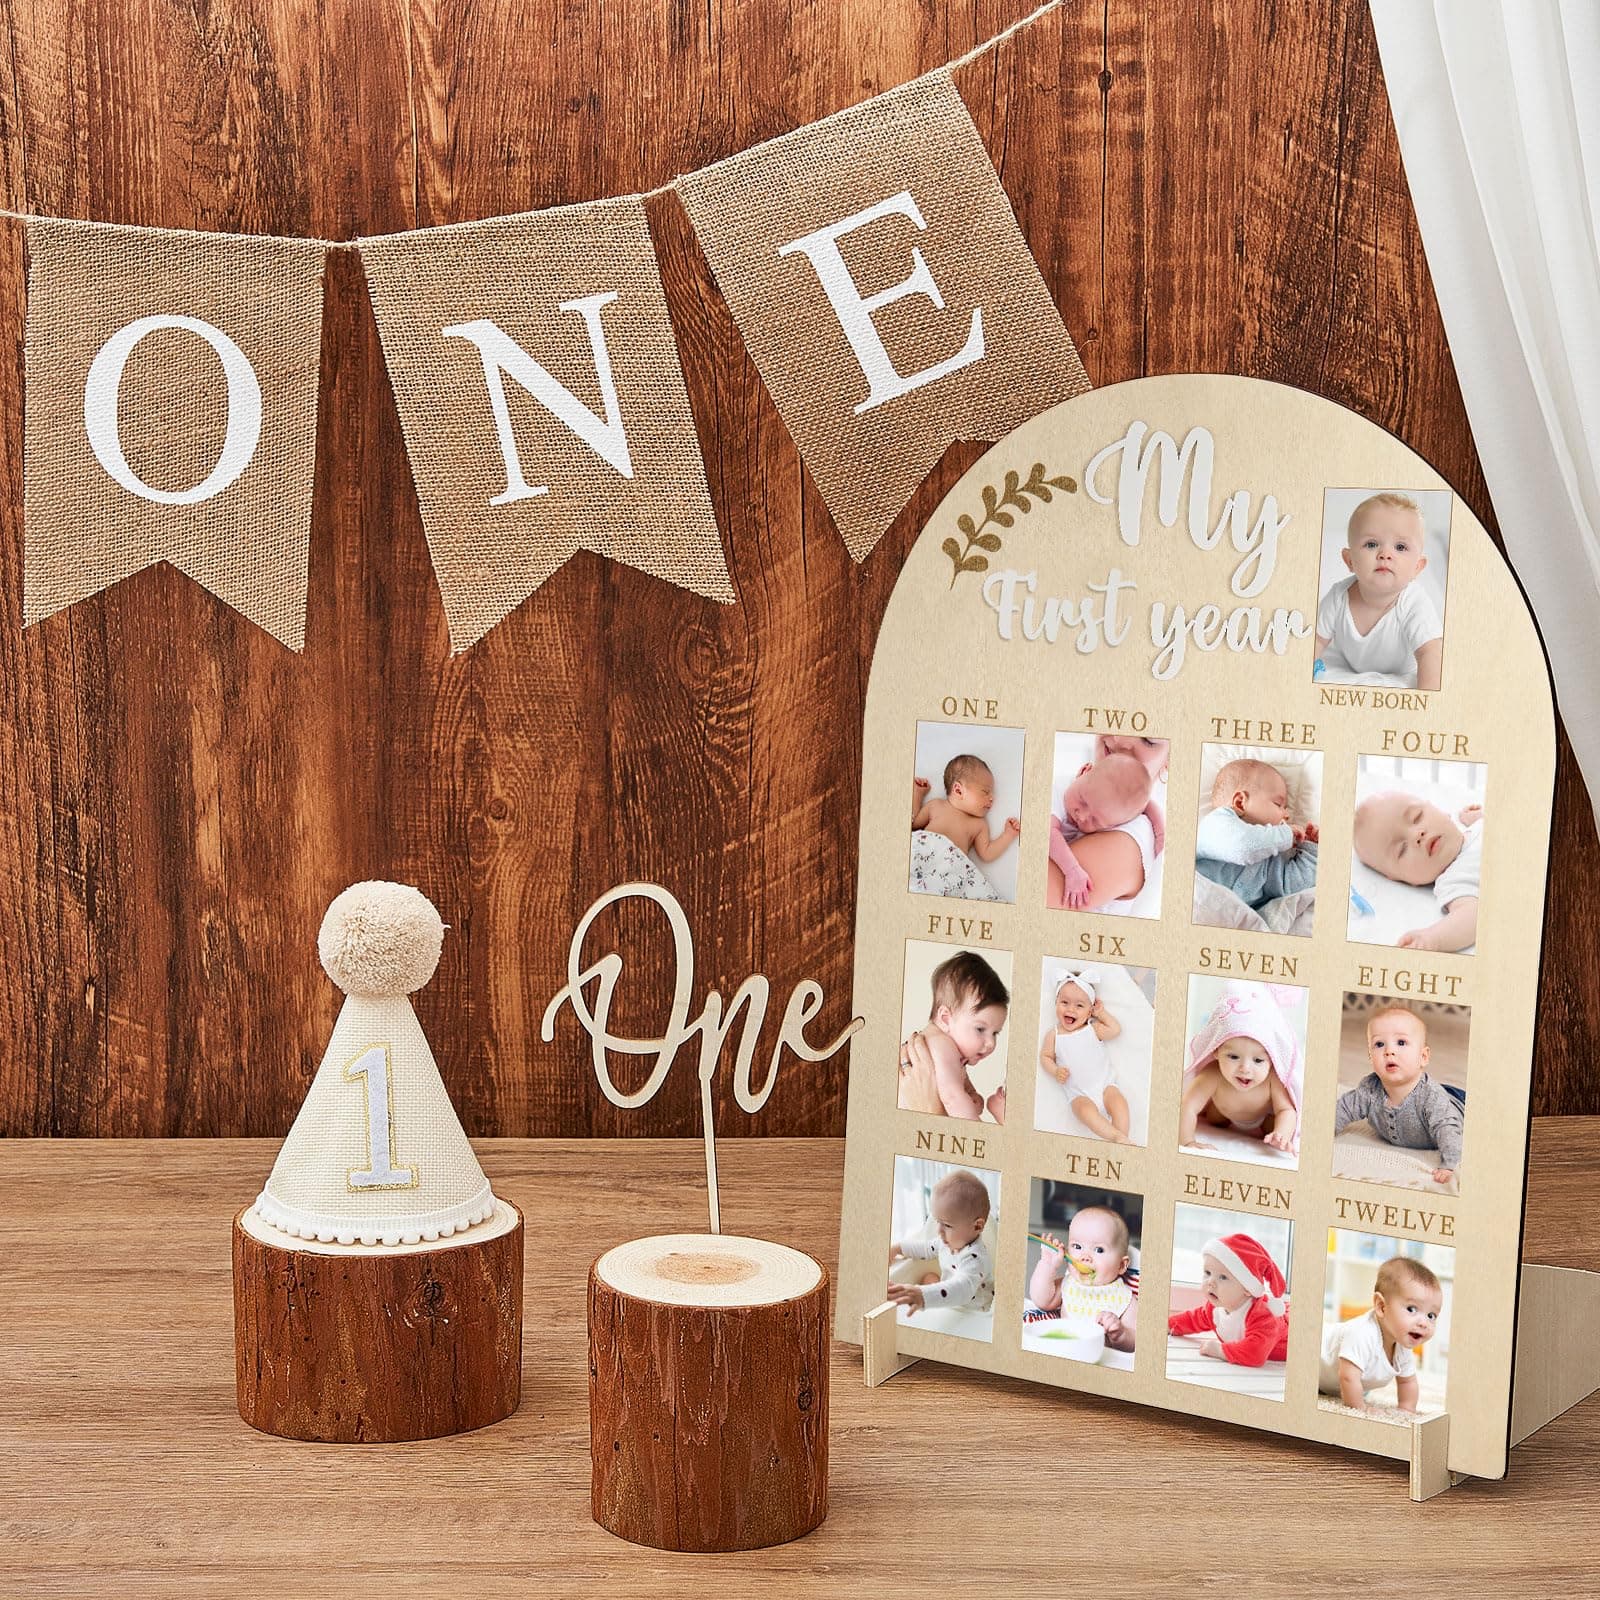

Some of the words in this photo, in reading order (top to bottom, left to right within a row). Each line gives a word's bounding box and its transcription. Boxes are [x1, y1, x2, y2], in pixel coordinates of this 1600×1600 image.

[1085, 420, 1293, 599] My
[982, 568, 1139, 655] First
[1148, 599, 1313, 682] year
[942, 697, 999, 720] ONE
[1320, 688, 1368, 708] NEW
[1372, 690, 1429, 711] BORN
[1084, 707, 1148, 732] TWO
[1211, 718, 1317, 745] THREE
[1381, 729, 1471, 757] FOUR
[927, 914, 994, 941] FIVE
[1079, 932, 1127, 957] SIX
[1198, 947, 1299, 978] SEVEN
[1356, 965, 1463, 998] EIGHT
[541, 880, 866, 1114] One
[343, 1041, 418, 1193] 1
[915, 1130, 987, 1160] NINE
[1066, 1153, 1124, 1182] TEN
[1183, 1174, 1293, 1211] ELEVEN
[1335, 1197, 1456, 1237] TWELVE
